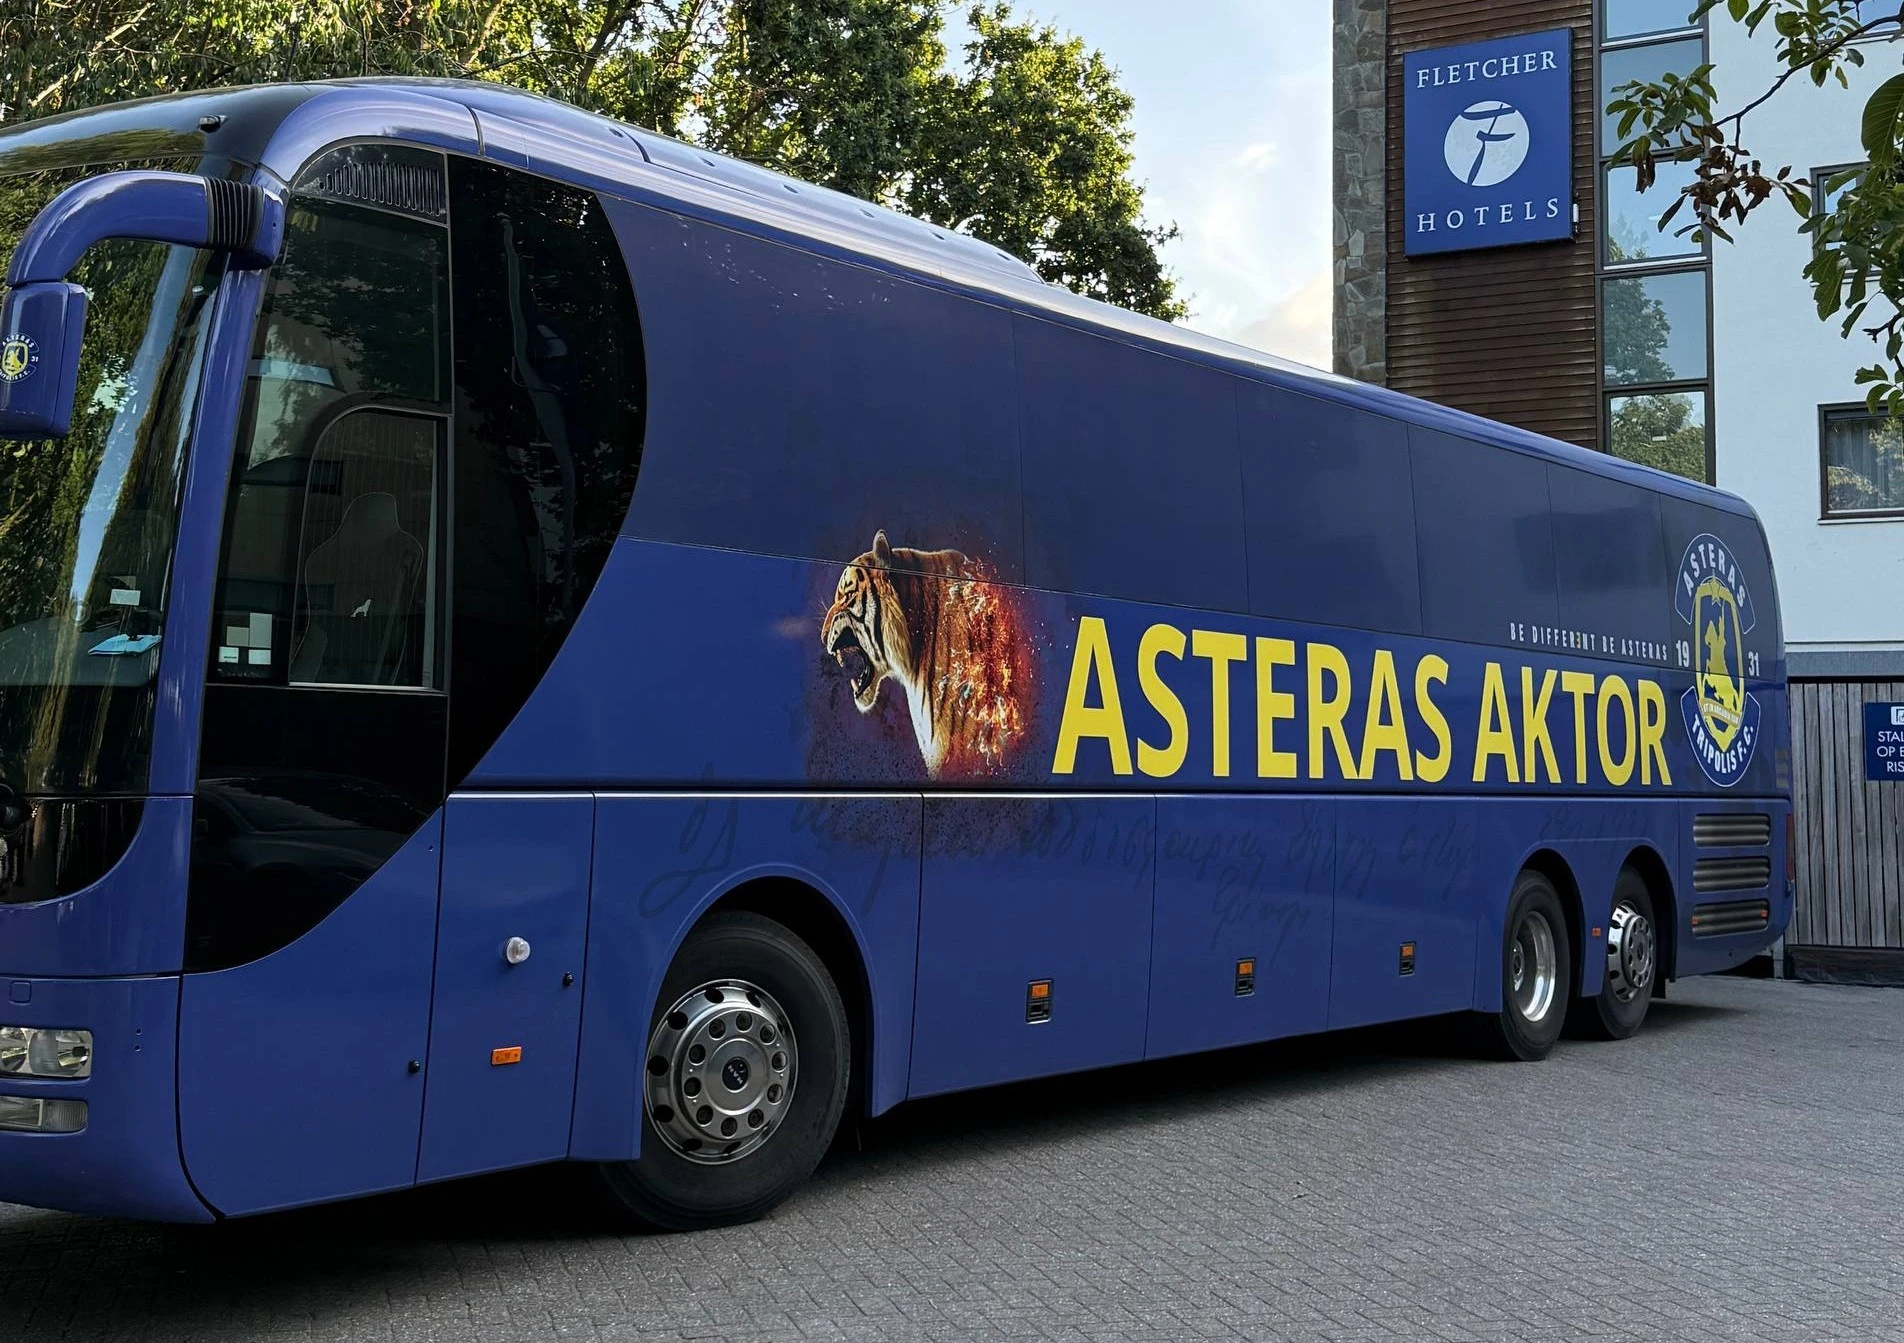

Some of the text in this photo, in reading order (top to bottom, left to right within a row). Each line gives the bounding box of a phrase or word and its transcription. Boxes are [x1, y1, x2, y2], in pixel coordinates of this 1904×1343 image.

[1417, 50, 1557, 88] FLETCHER
[1417, 198, 1559, 232] HOTELS
[1683, 543, 1746, 608] ASTERAS
[1510, 622, 1524, 642] BE
[1602, 635, 1615, 654] BE
[1621, 638, 1667, 661] ASTERAS
[1676, 639, 1690, 668] 19
[1748, 651, 1760, 677] 31
[1052, 616, 1672, 786] ASTERAS AKTOR
[1692, 713, 1737, 774] TRIPOLIS
[1877, 746, 1895, 757] OP
